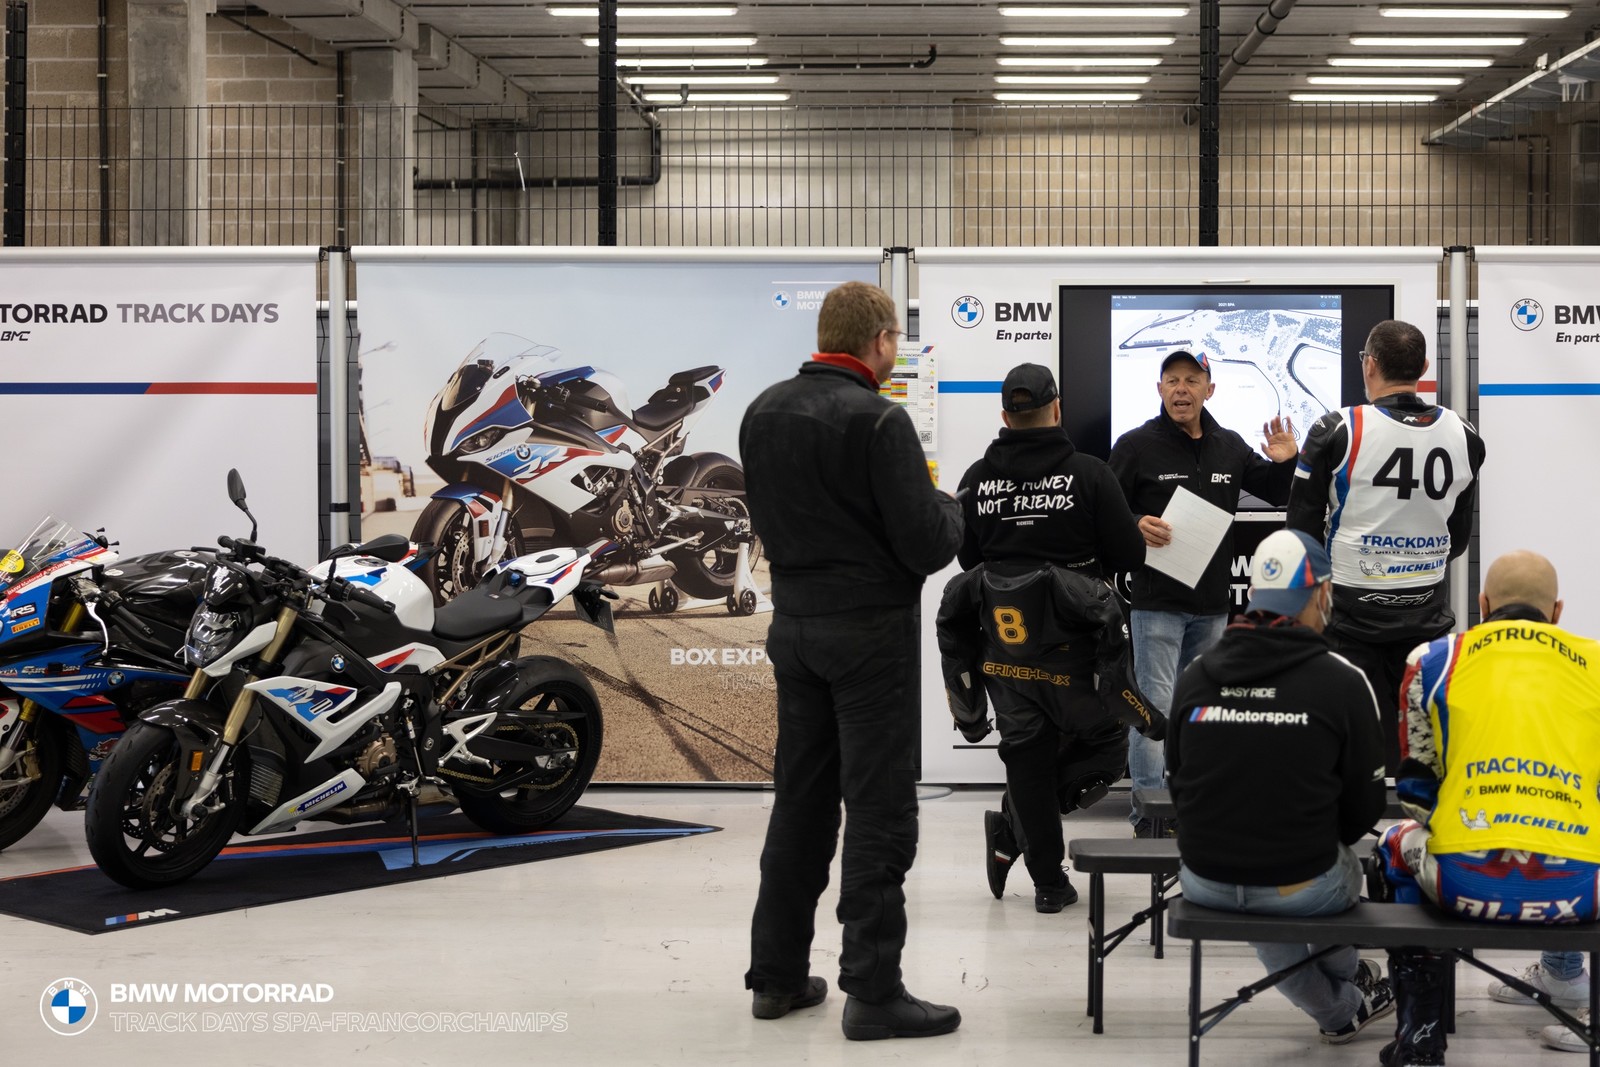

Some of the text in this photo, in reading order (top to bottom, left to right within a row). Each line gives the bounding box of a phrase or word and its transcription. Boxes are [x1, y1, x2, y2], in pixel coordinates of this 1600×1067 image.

[797, 291, 825, 299] BMW
[117, 303, 205, 323] TRACK
[211, 303, 279, 323] DAYS
[0, 331, 30, 342] BMC
[996, 330, 1012, 340] En
[1556, 332, 1572, 343] En
[1372, 447, 1453, 500] 40
[977, 479, 1017, 496] MAKE
[977, 494, 1075, 516] NOT FRIENDS
[1361, 535, 1449, 548] TRACKDAYS
[1387, 558, 1445, 574] MICHELIN
[993, 606, 1028, 644] 8
[670, 648, 717, 665] BOX
[1468, 627, 1588, 670] INSTRUCTEUR
[1250, 687, 1277, 698] RIDE
[1466, 757, 1583, 790] TRACKDAYS
[304, 783, 344, 808] MICHELIN
[1479, 784, 1511, 796] BMW
[1493, 813, 1590, 835] MICHELIN
[1456, 896, 1583, 922] ALEX
